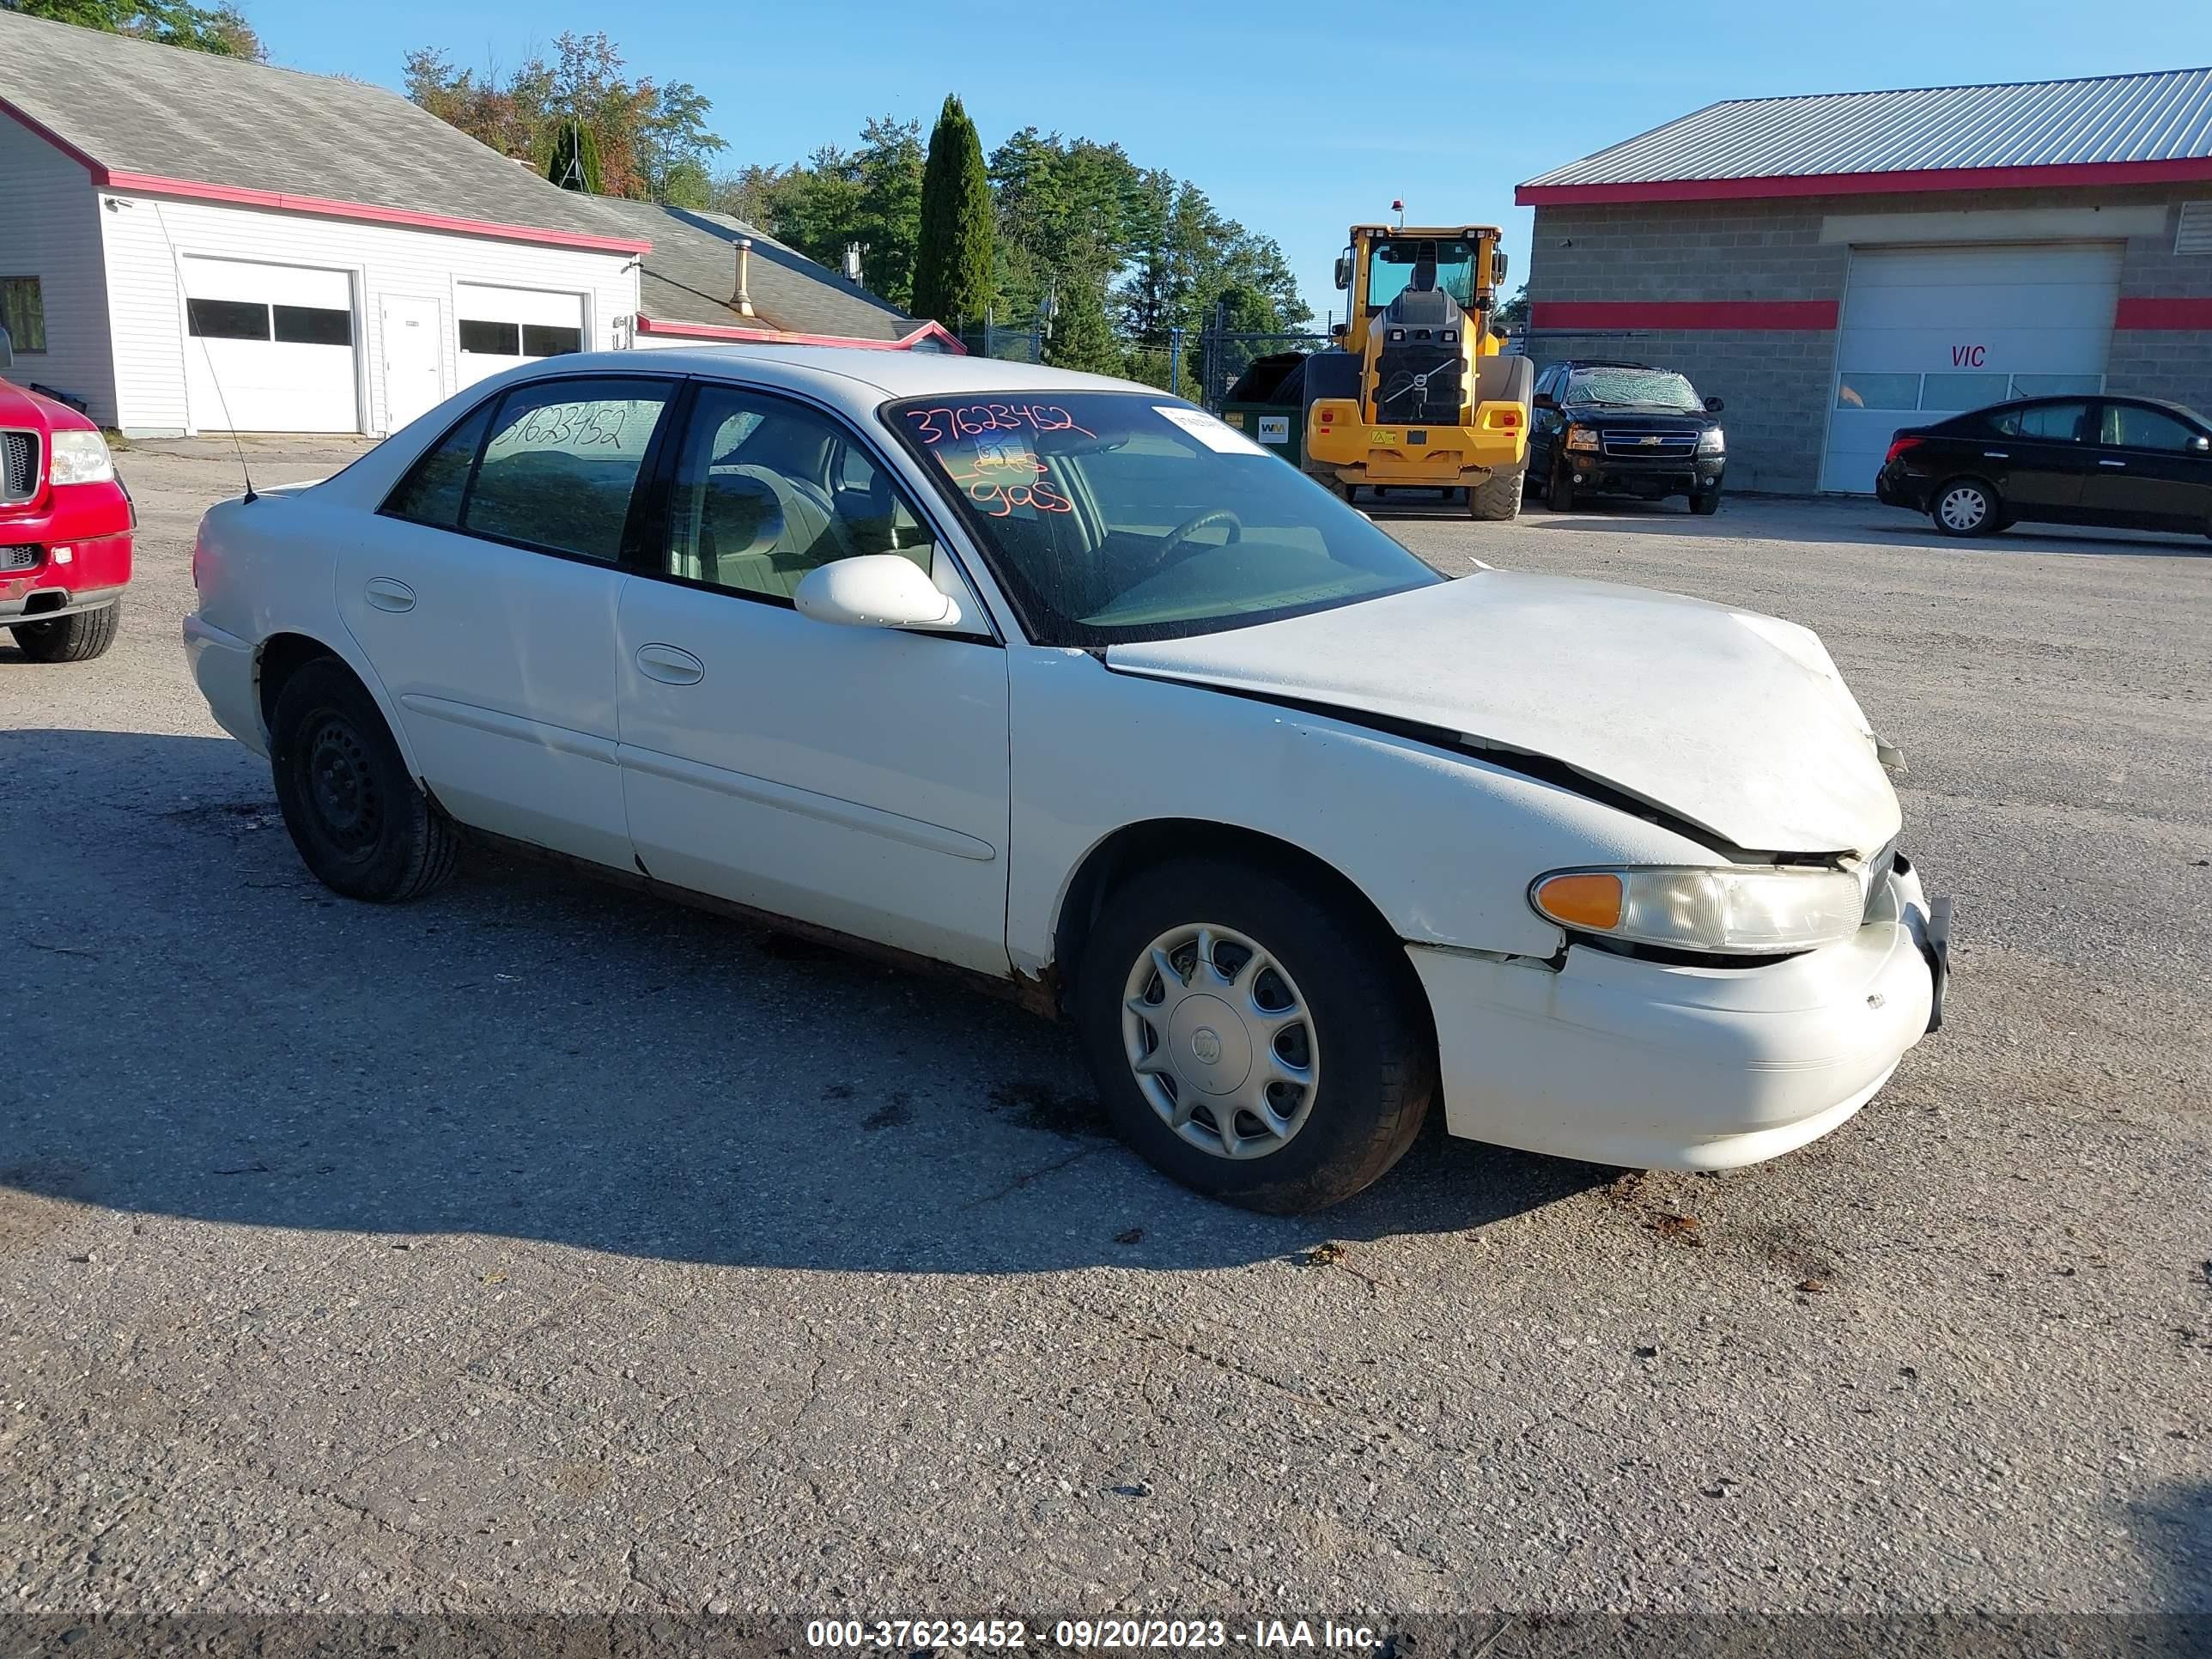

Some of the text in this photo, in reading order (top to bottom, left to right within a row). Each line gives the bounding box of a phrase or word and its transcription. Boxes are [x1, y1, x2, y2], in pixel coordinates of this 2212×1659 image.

[1952, 345, 1986, 368] VIC
[906, 404, 1098, 445] 37623452
[1261, 423, 1285, 433] WM
[969, 481, 1073, 517] gas
